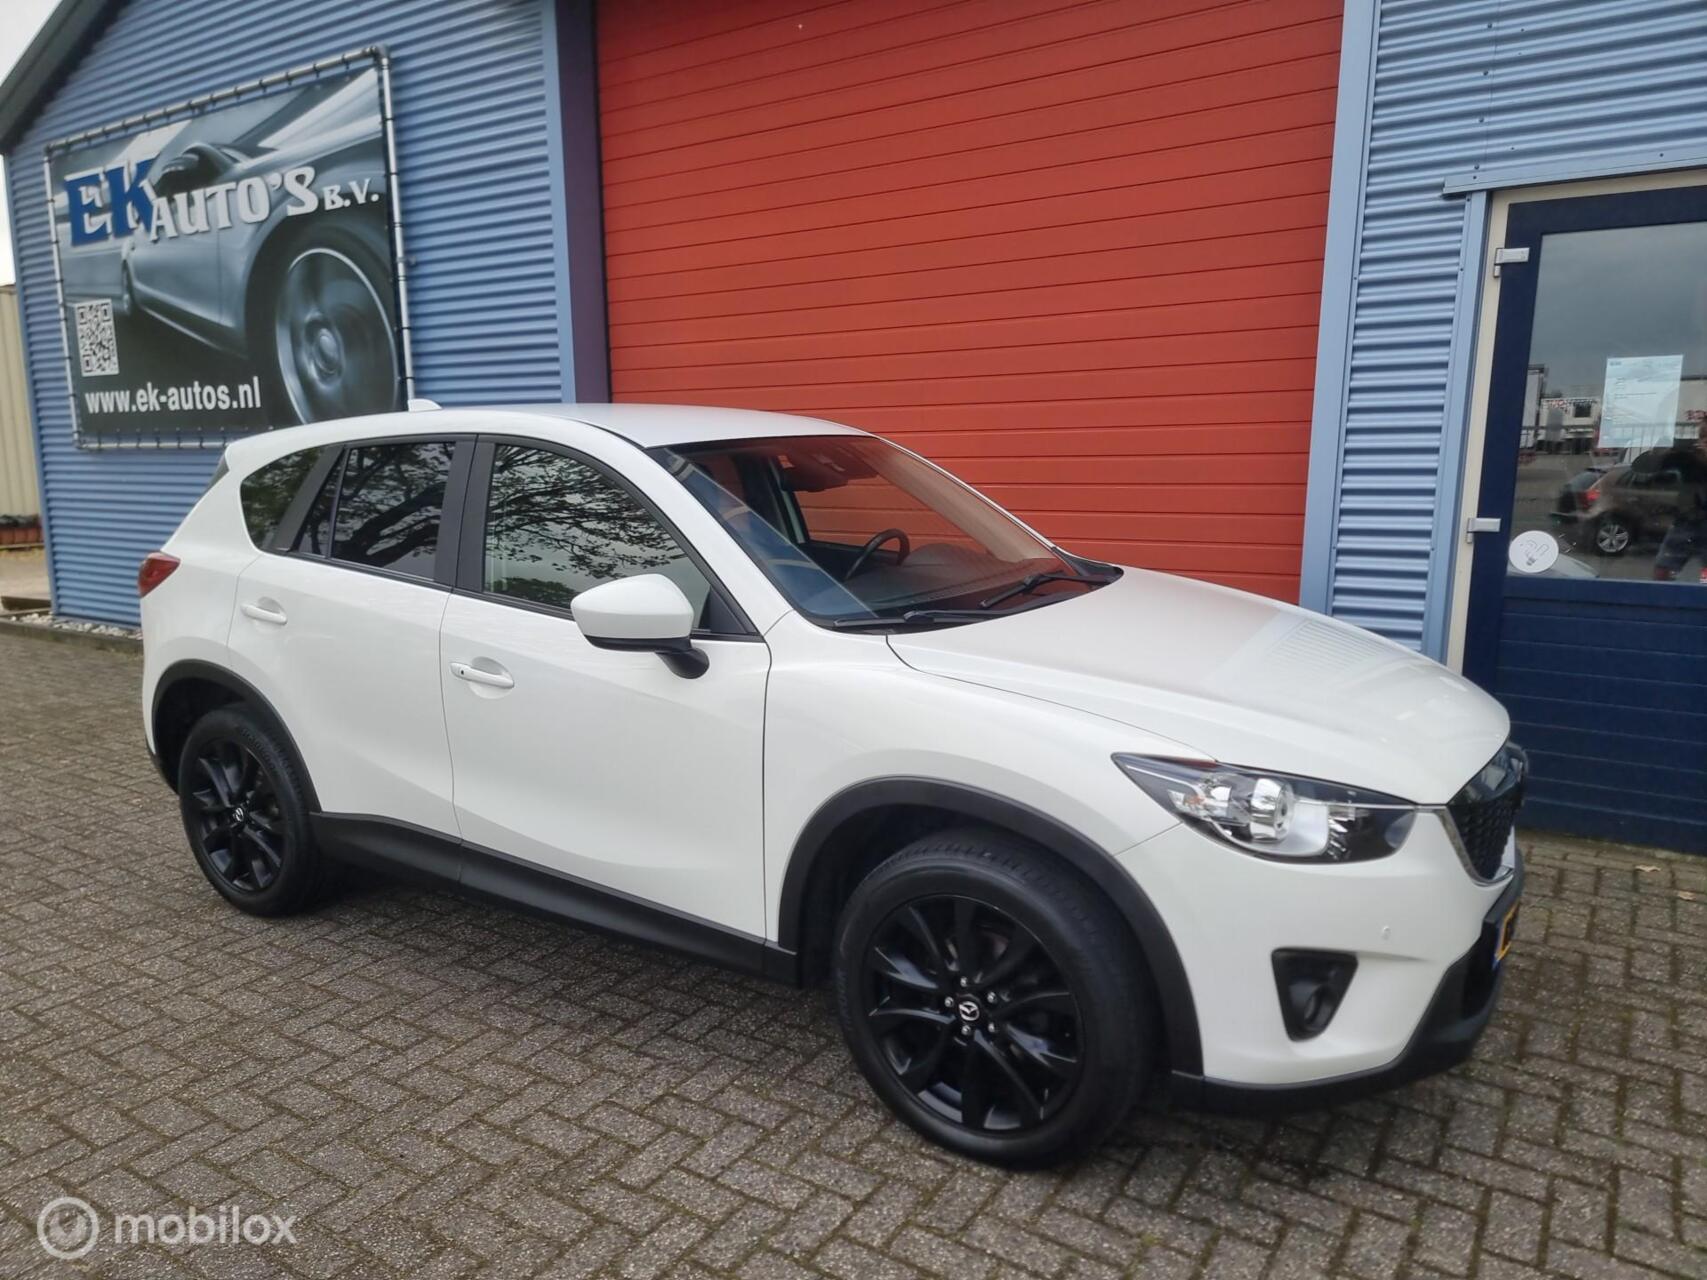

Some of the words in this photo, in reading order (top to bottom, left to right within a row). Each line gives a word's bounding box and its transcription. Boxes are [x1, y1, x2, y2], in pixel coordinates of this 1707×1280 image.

[64, 158, 155, 246] EK
[150, 166, 319, 241] AUTO'S
[322, 178, 380, 211] B.V.
[84, 376, 262, 414] www.ek-autos.nl
